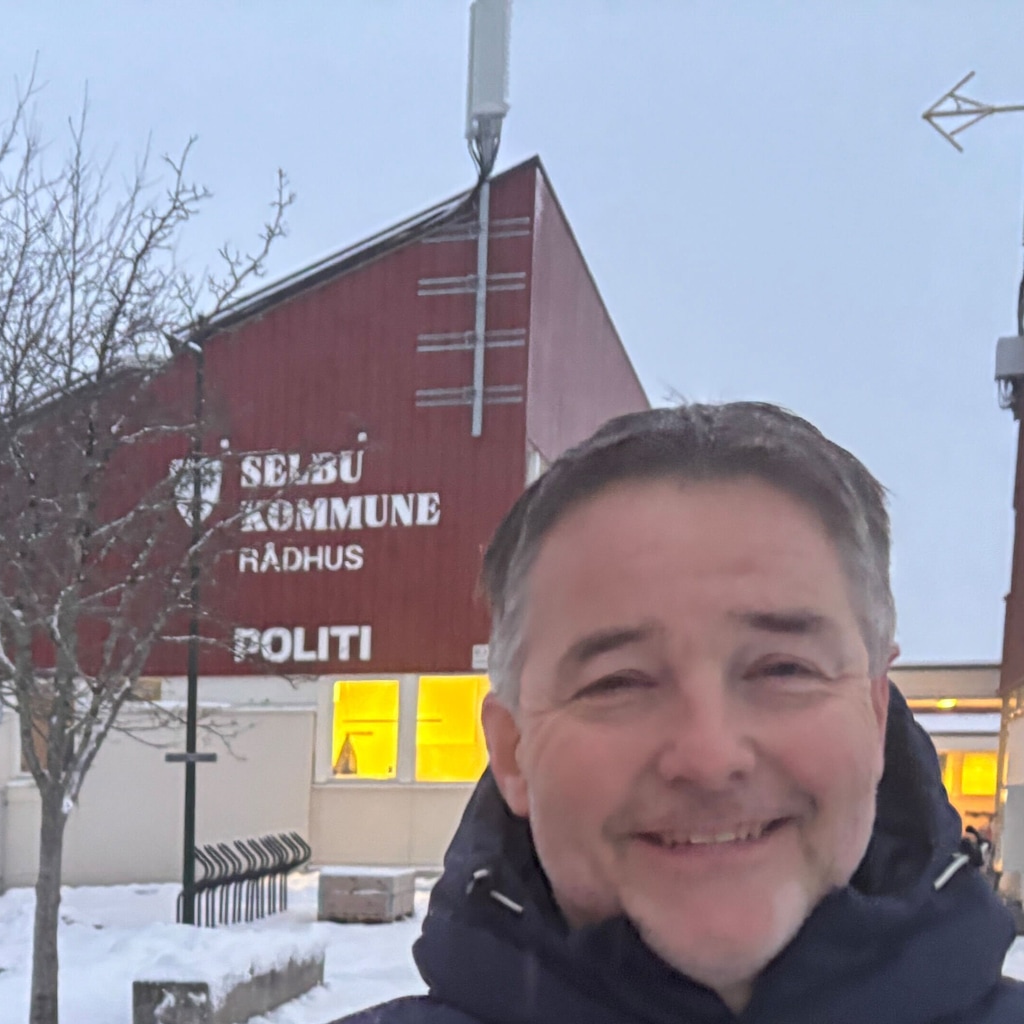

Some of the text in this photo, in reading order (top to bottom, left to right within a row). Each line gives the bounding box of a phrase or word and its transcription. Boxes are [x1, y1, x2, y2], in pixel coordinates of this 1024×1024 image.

[240, 450, 364, 488] SELBU
[240, 492, 441, 532] KOMMUNE
[238, 542, 364, 573] RÅDHUS
[233, 625, 372, 663] POLITI
